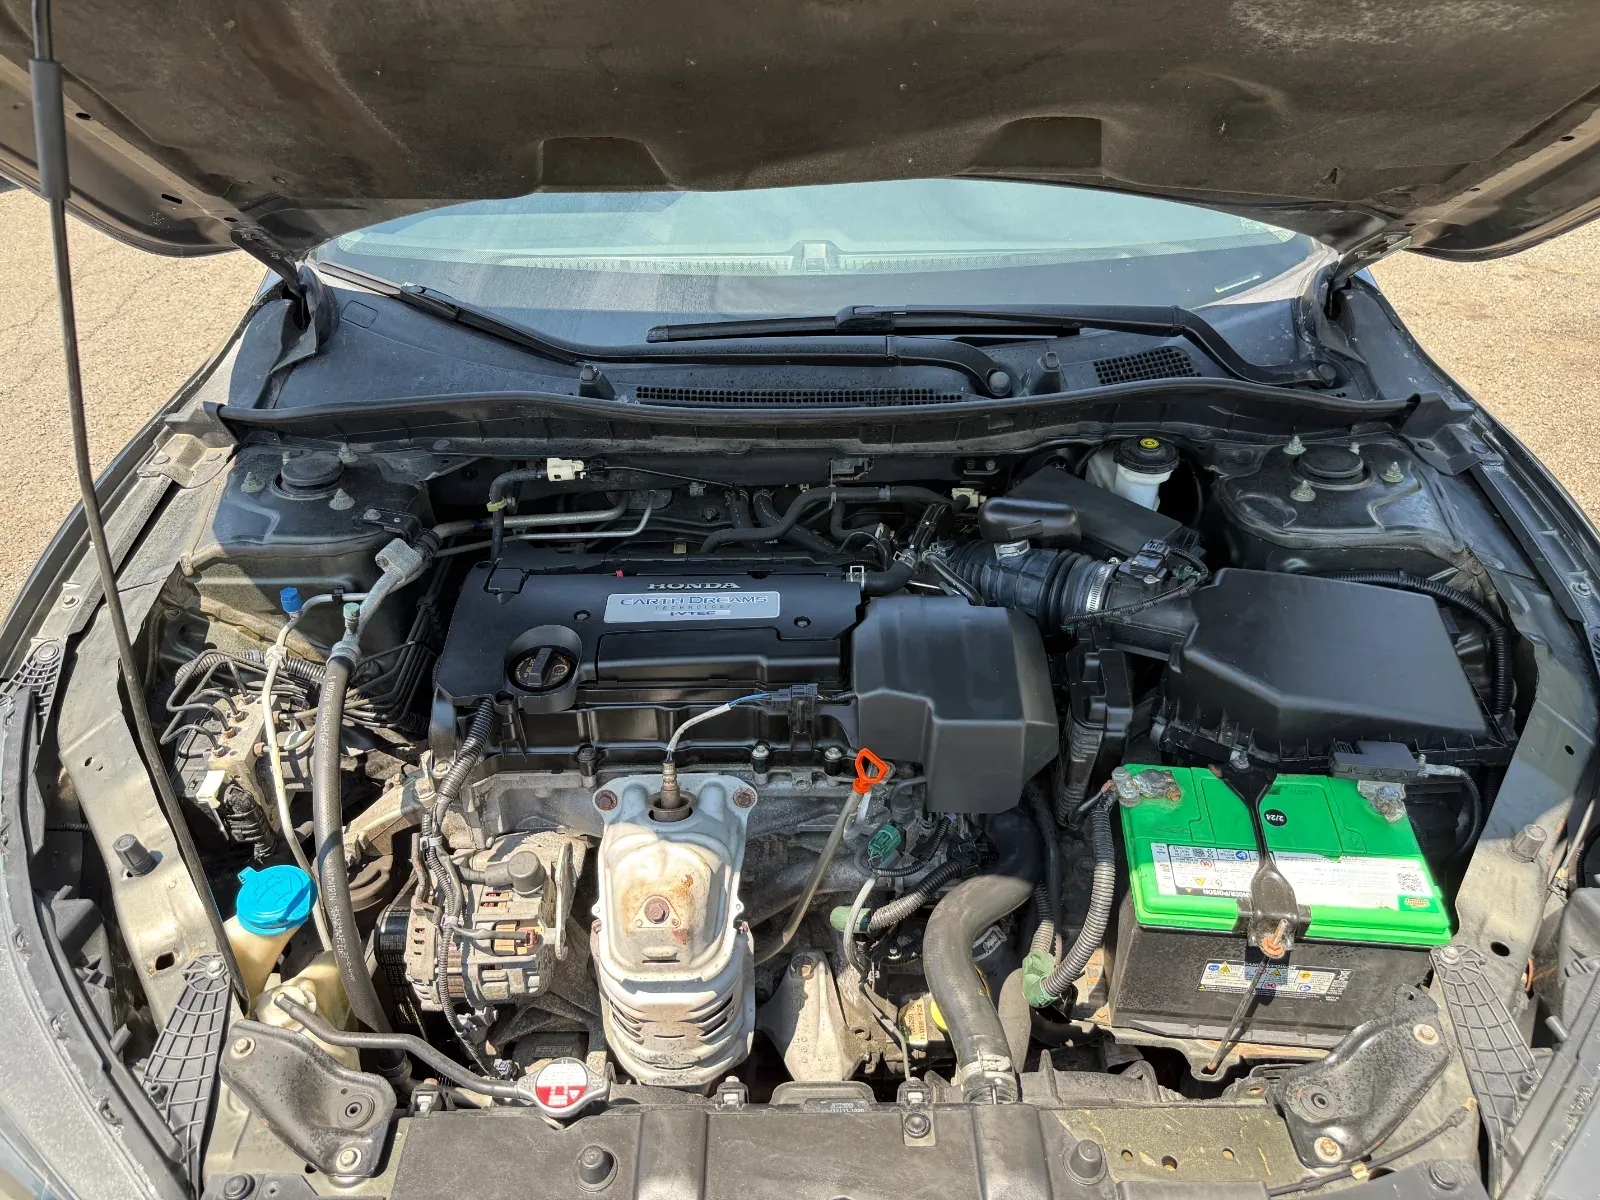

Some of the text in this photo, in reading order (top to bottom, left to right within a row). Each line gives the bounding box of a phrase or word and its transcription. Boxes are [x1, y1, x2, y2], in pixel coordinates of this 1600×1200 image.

[620, 596, 768, 606] EARTH DREAMS
[1266, 813, 1284, 822] 2/24
